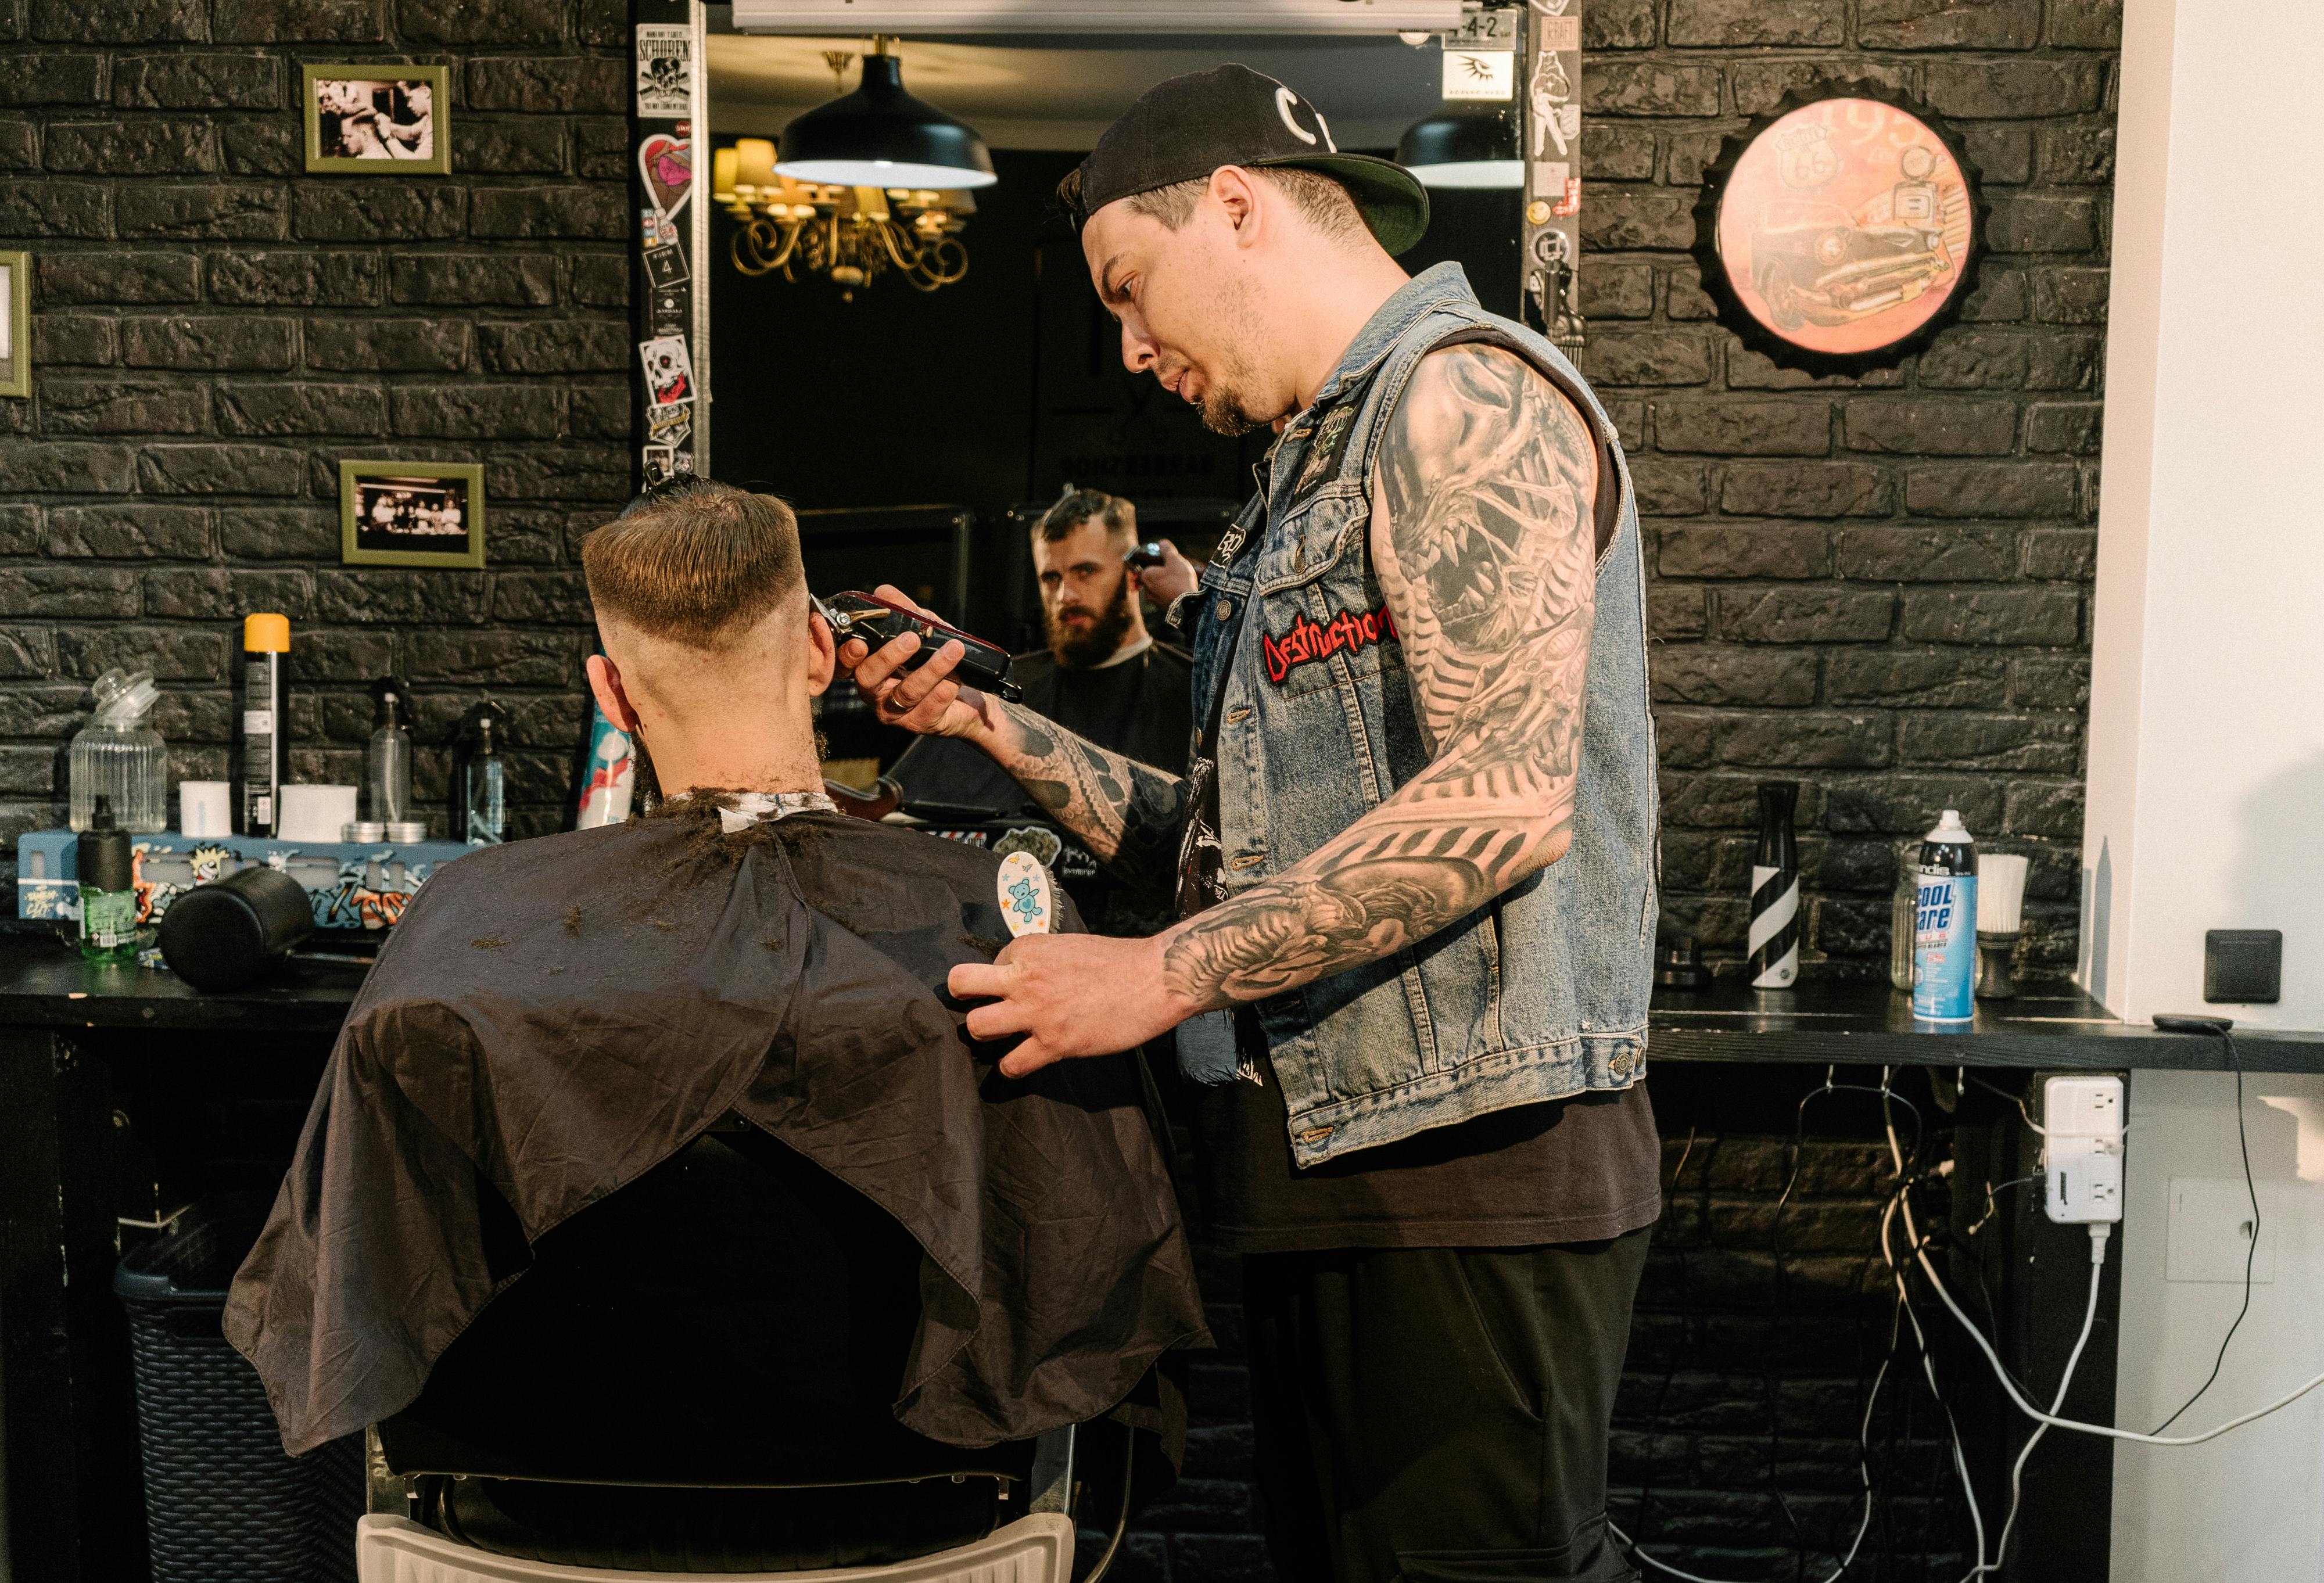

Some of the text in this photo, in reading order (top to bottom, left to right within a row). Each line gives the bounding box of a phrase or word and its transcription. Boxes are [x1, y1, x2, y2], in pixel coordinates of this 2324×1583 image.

[652, 248, 673, 260] FIRM
[662, 260, 673, 274] 4
[1917, 908, 1951, 930] are
